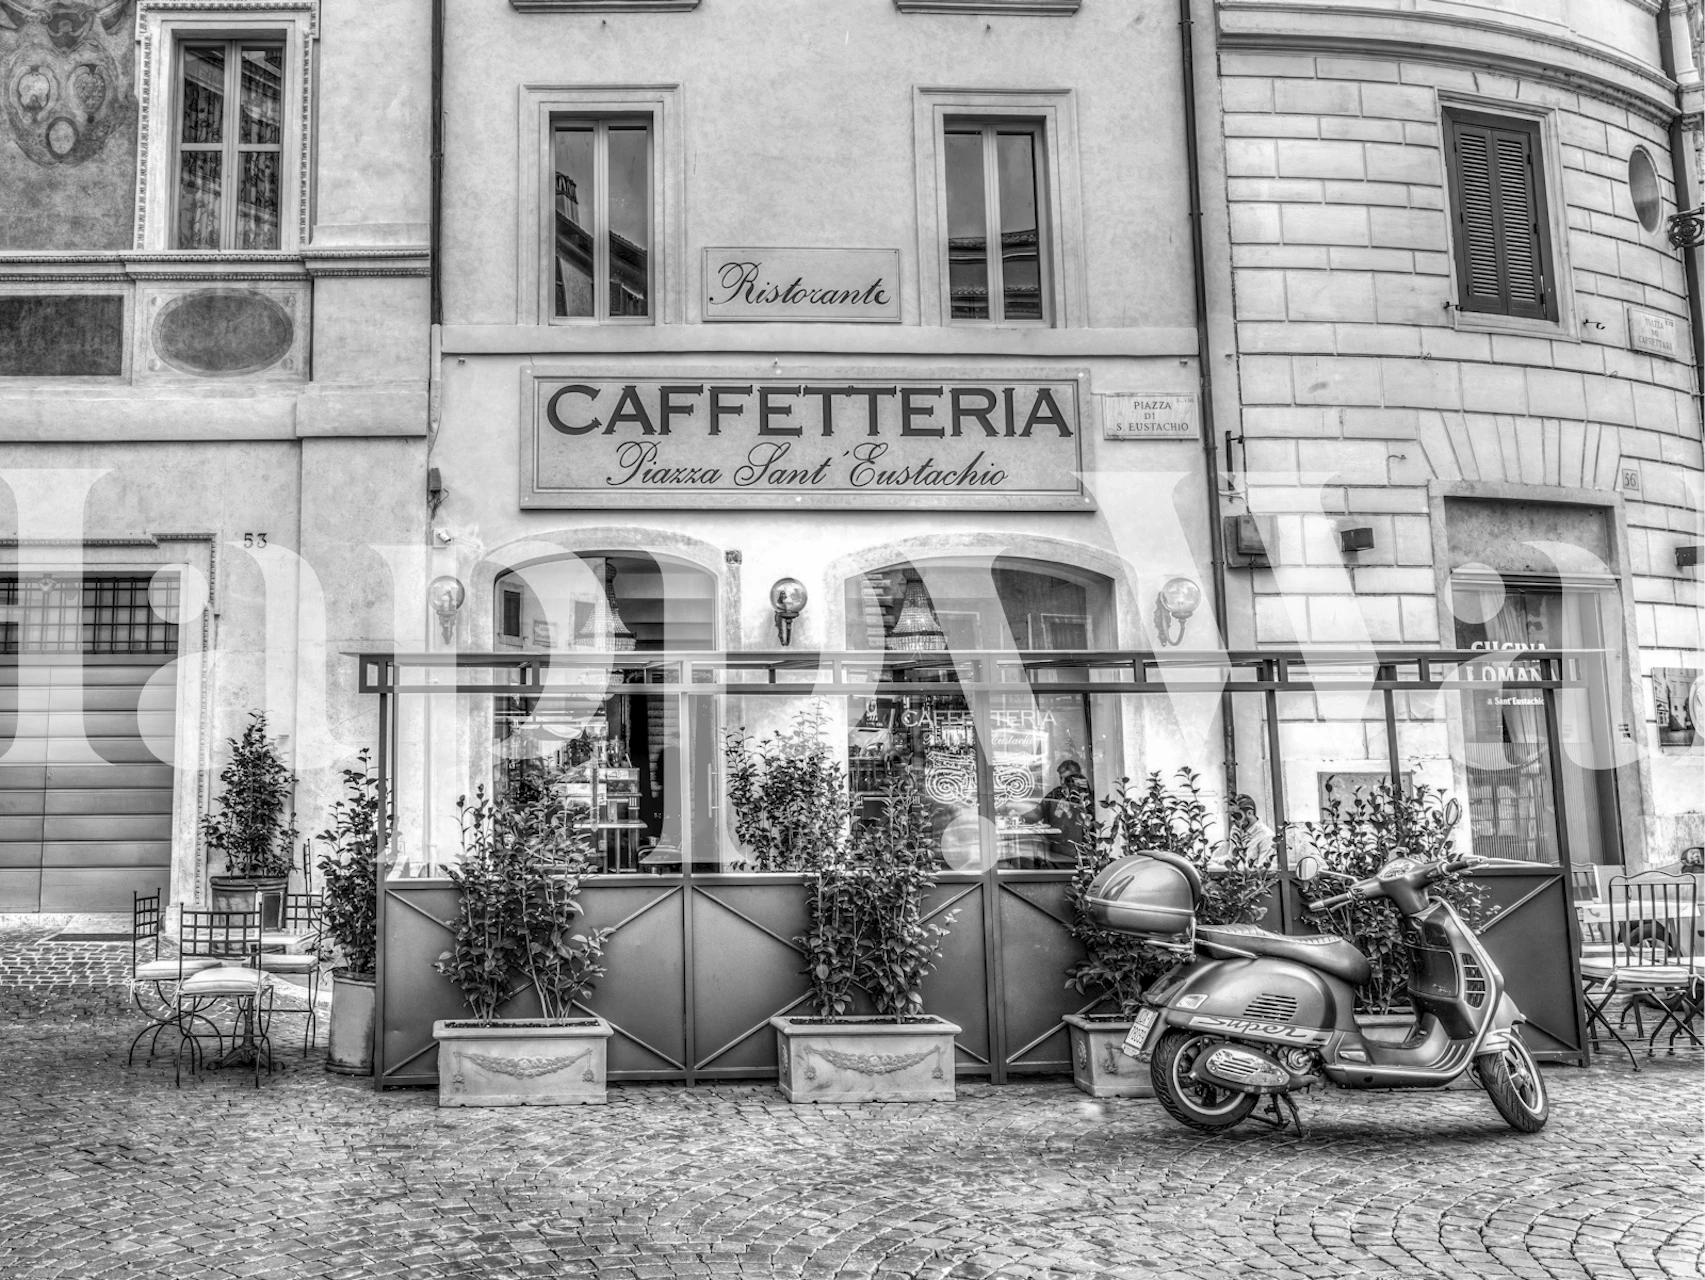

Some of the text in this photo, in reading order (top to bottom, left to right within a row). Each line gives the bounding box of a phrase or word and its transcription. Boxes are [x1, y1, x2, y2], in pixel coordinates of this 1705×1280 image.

[709, 262, 892, 305] Ristorante
[547, 384, 1074, 438] CAFFETTERIA
[1134, 401, 1172, 410] PIAZZA
[1144, 412, 1155, 420] DI
[1116, 422, 1189, 432] S. EUSTACHIO
[606, 440, 723, 487] Piazza
[1624, 472, 1637, 487] 56
[243, 532, 268, 549] 53
